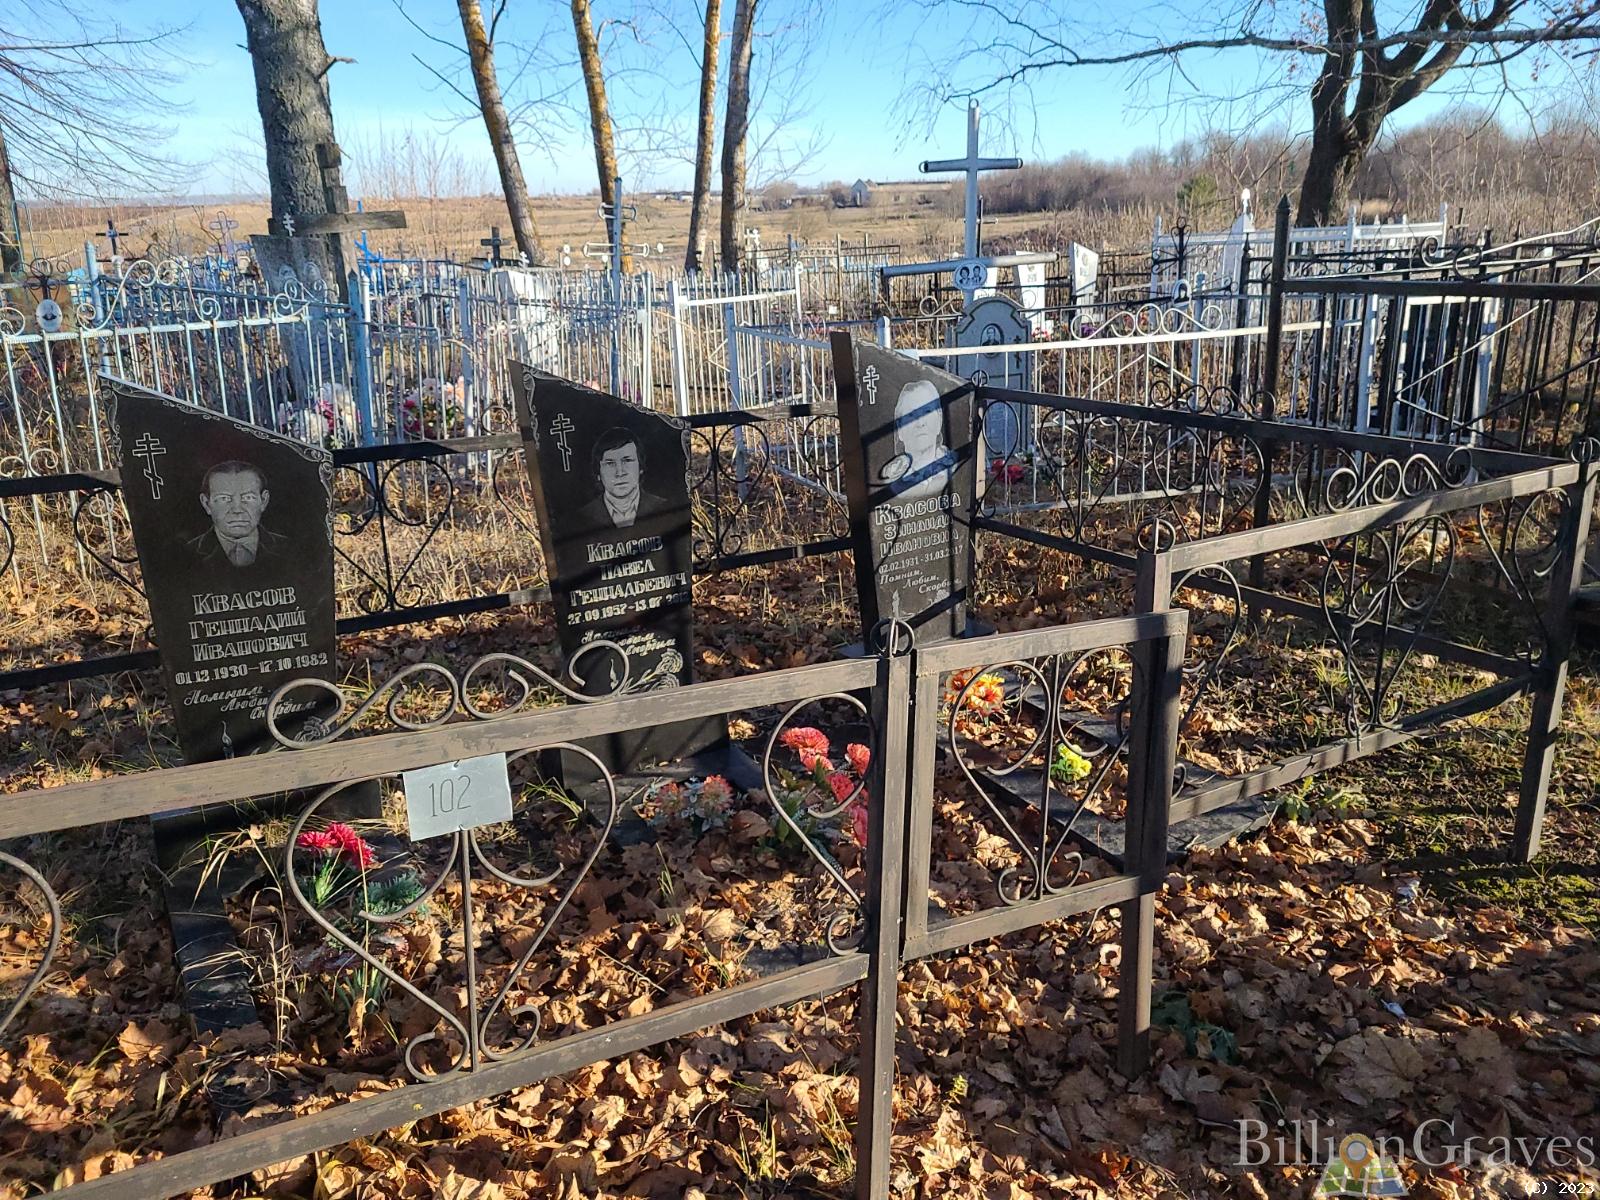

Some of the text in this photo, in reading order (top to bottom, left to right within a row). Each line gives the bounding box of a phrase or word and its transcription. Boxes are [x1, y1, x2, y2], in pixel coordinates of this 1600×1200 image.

[875, 492, 961, 525] КВАСОВА
[586, 536, 663, 563] КВАСОВ
[924, 545, 963, 562] 31.03.217
[601, 559, 655, 580] ПАВЕЛ
[192, 586, 296, 615] КВАСОВ
[569, 572, 687, 607] ГЕННАДЬЕВИЧ
[189, 606, 307, 639] ГЕННАДИЙ
[192, 633, 309, 662] ИВАНОВИЧ
[429, 775, 471, 817] 102
